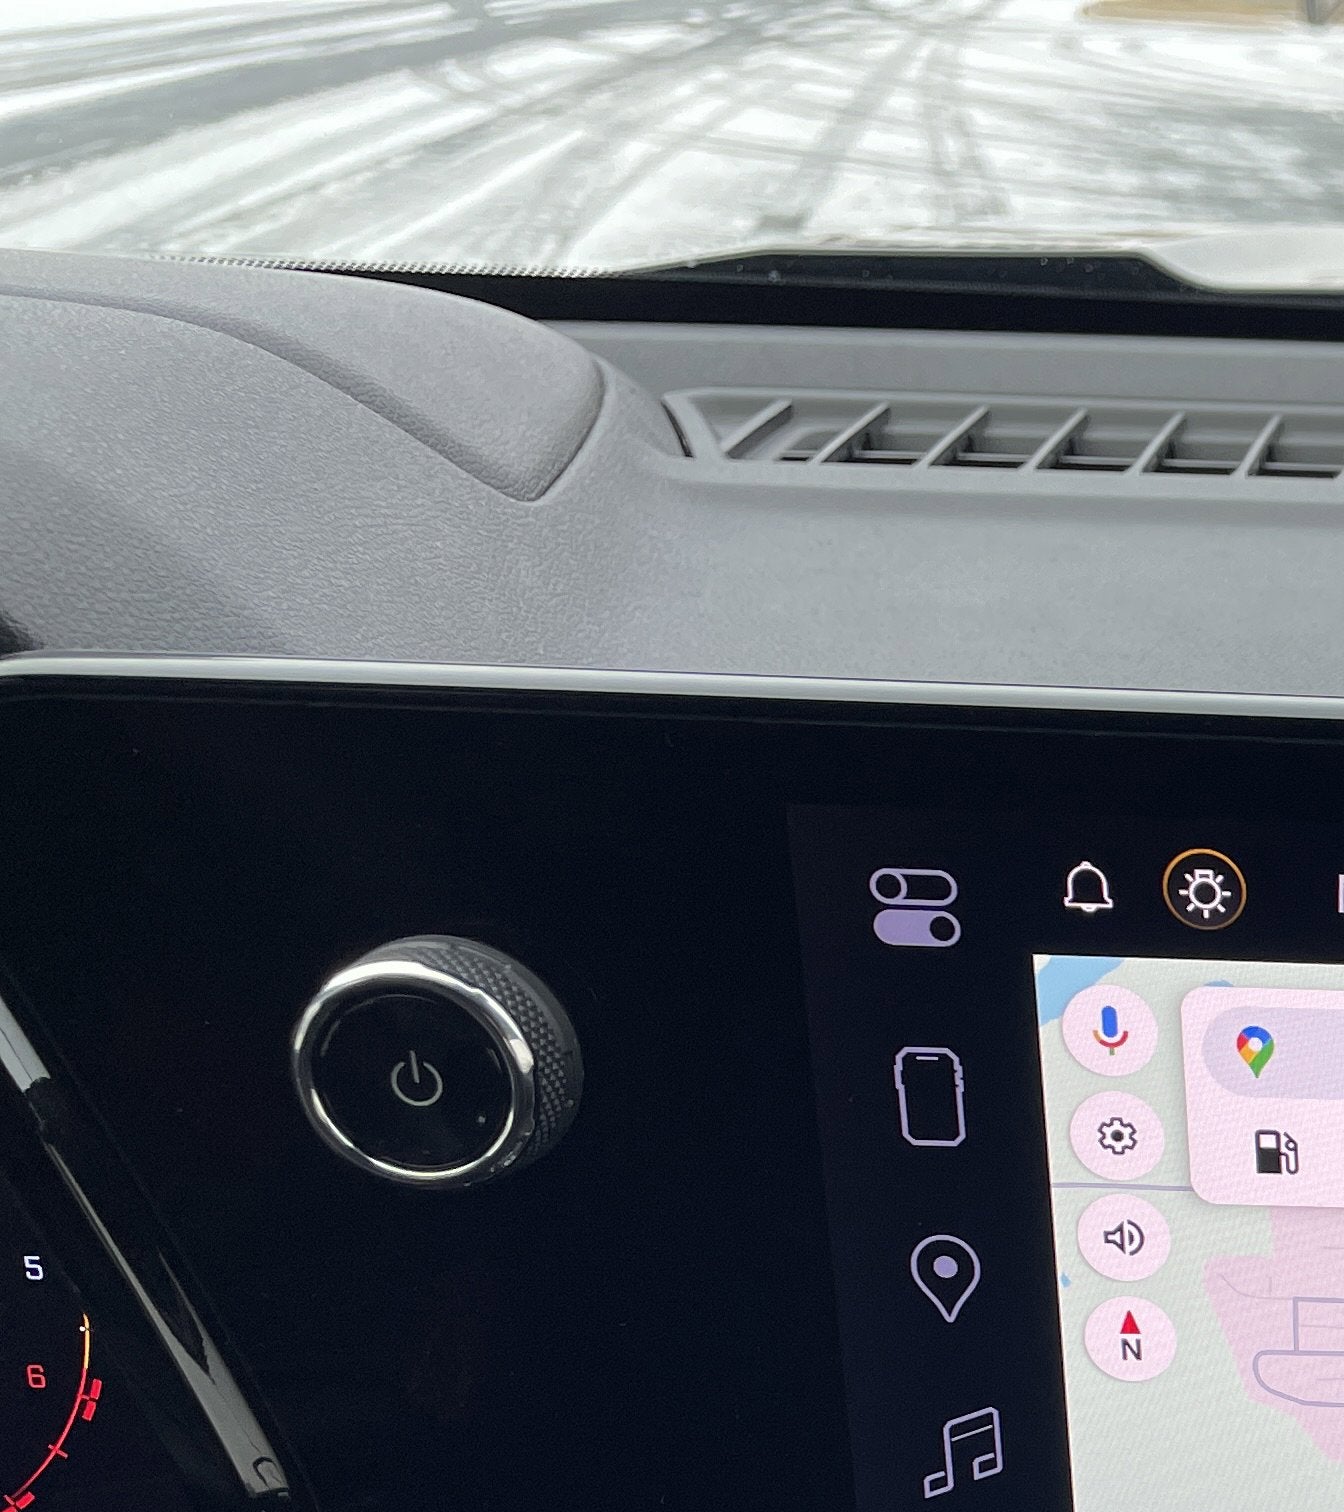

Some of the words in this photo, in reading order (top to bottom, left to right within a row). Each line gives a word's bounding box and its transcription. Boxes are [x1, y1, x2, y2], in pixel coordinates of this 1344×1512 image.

[23, 1255, 45, 1281] 5
[1121, 1337, 1142, 1362] N
[26, 1364, 46, 1389] 6
